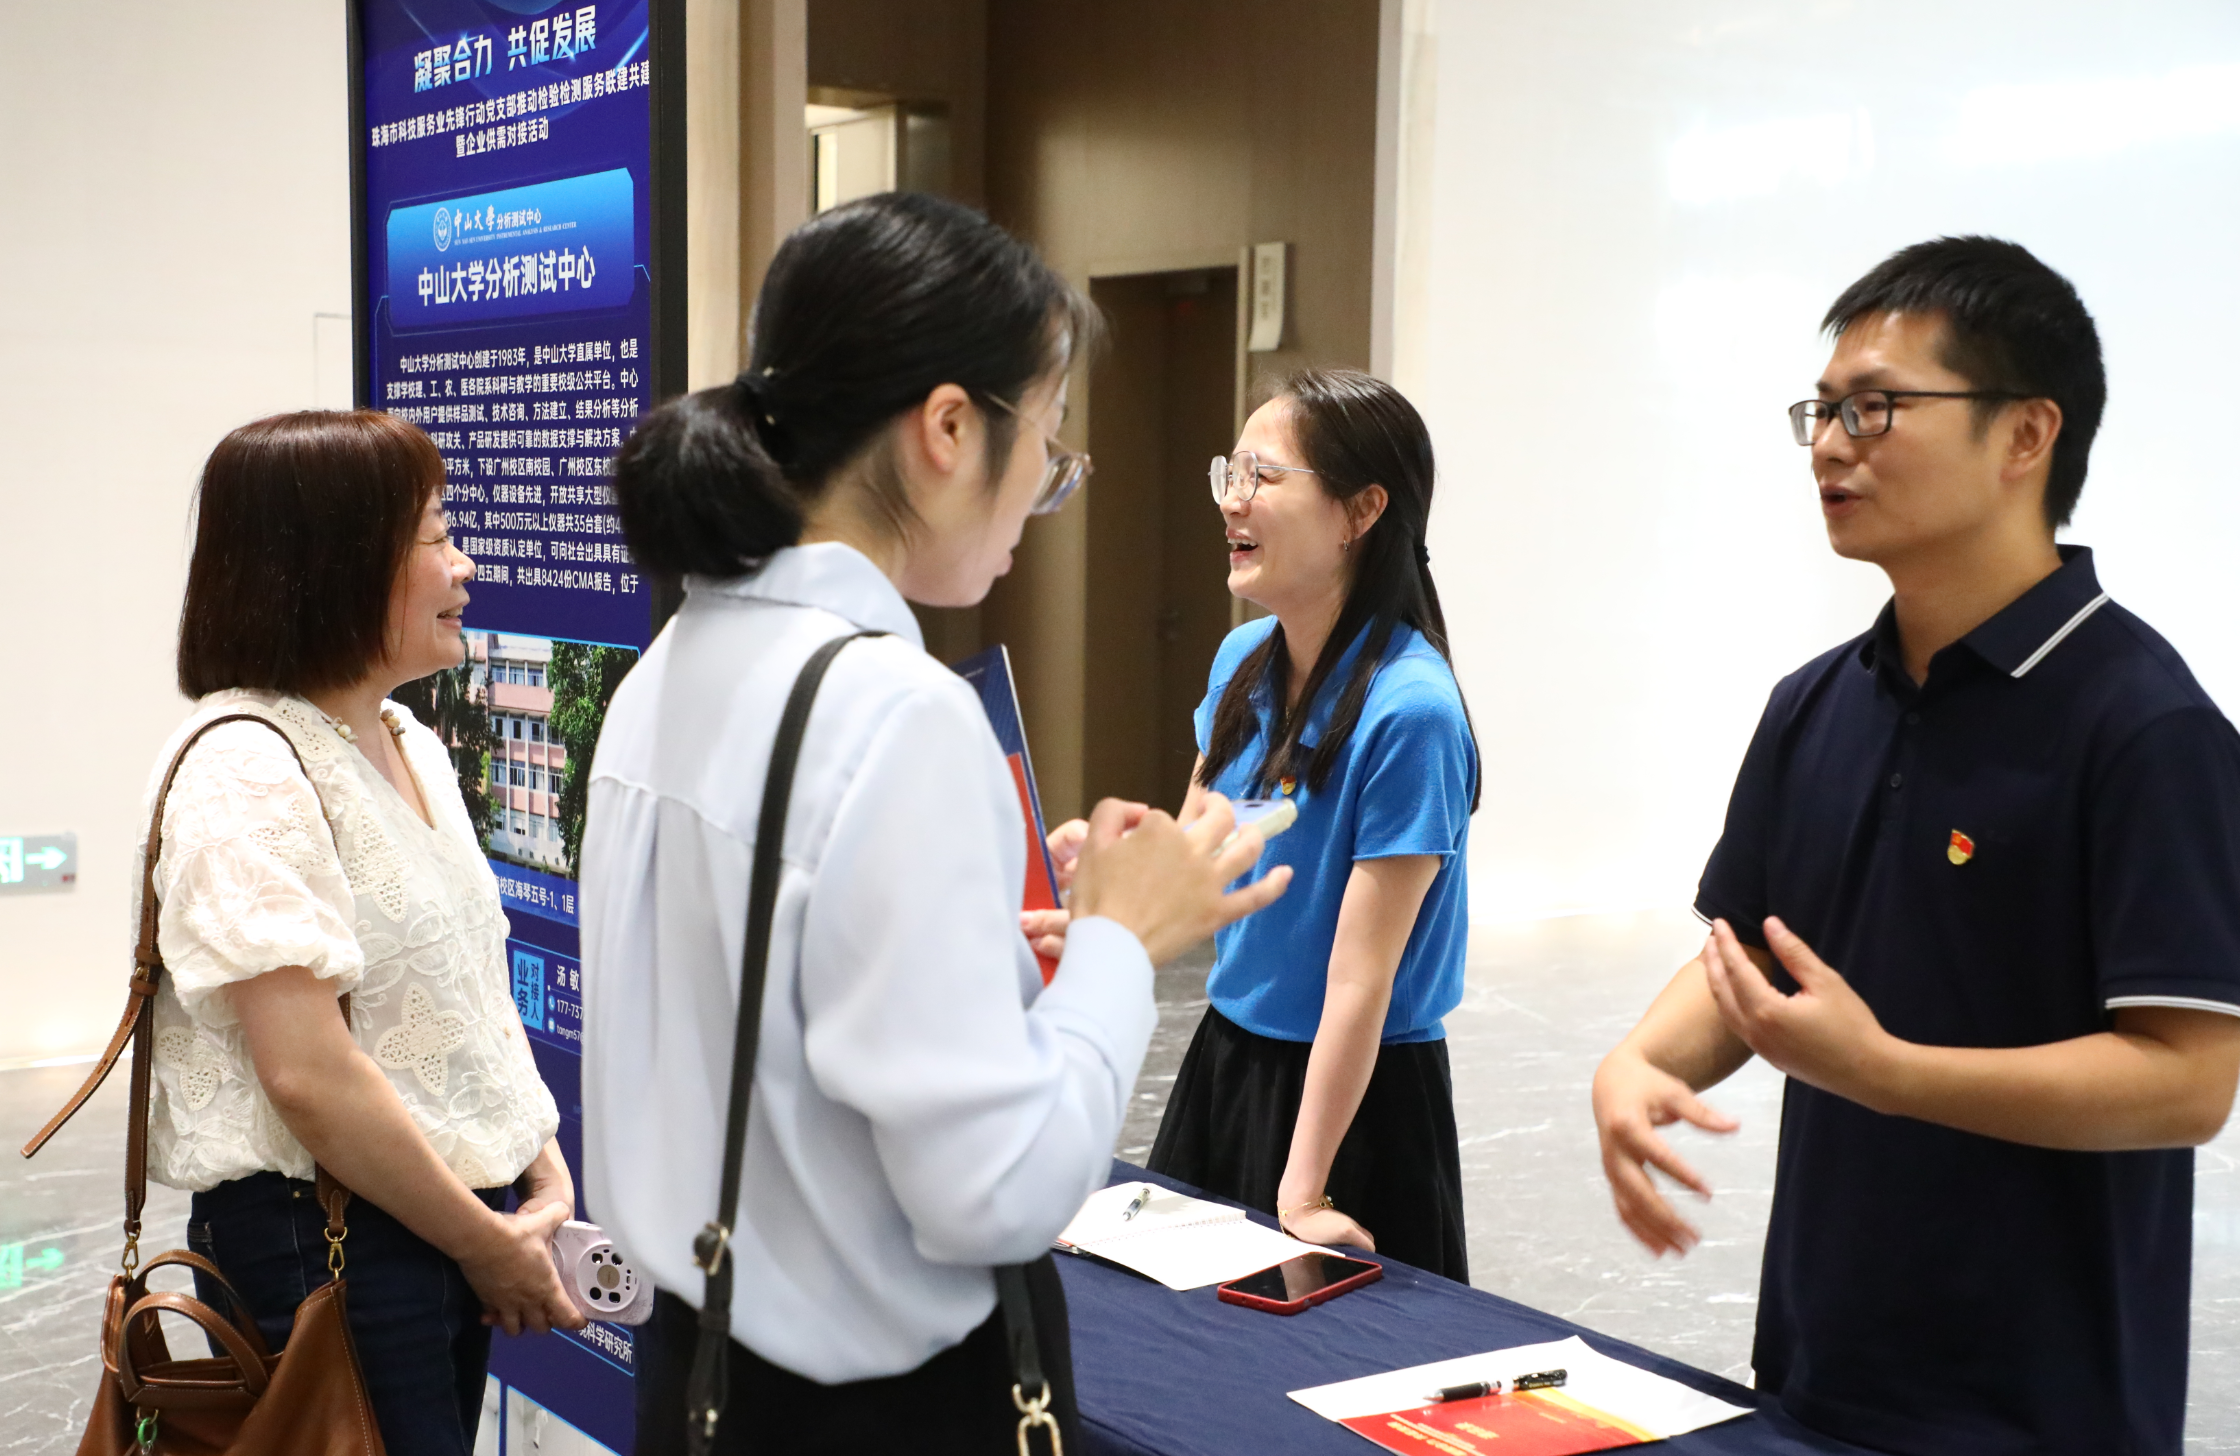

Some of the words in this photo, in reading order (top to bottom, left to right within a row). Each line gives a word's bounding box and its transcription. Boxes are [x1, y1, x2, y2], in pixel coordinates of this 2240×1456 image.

[414, 34, 493, 93] 凝聚合力
[508, 5, 597, 71] 共促发展
[456, 117, 549, 158] 暨企业供需对接活动
[417, 245, 596, 307] 中山大学分析测试中心
[517, 957, 530, 1017] 业务
